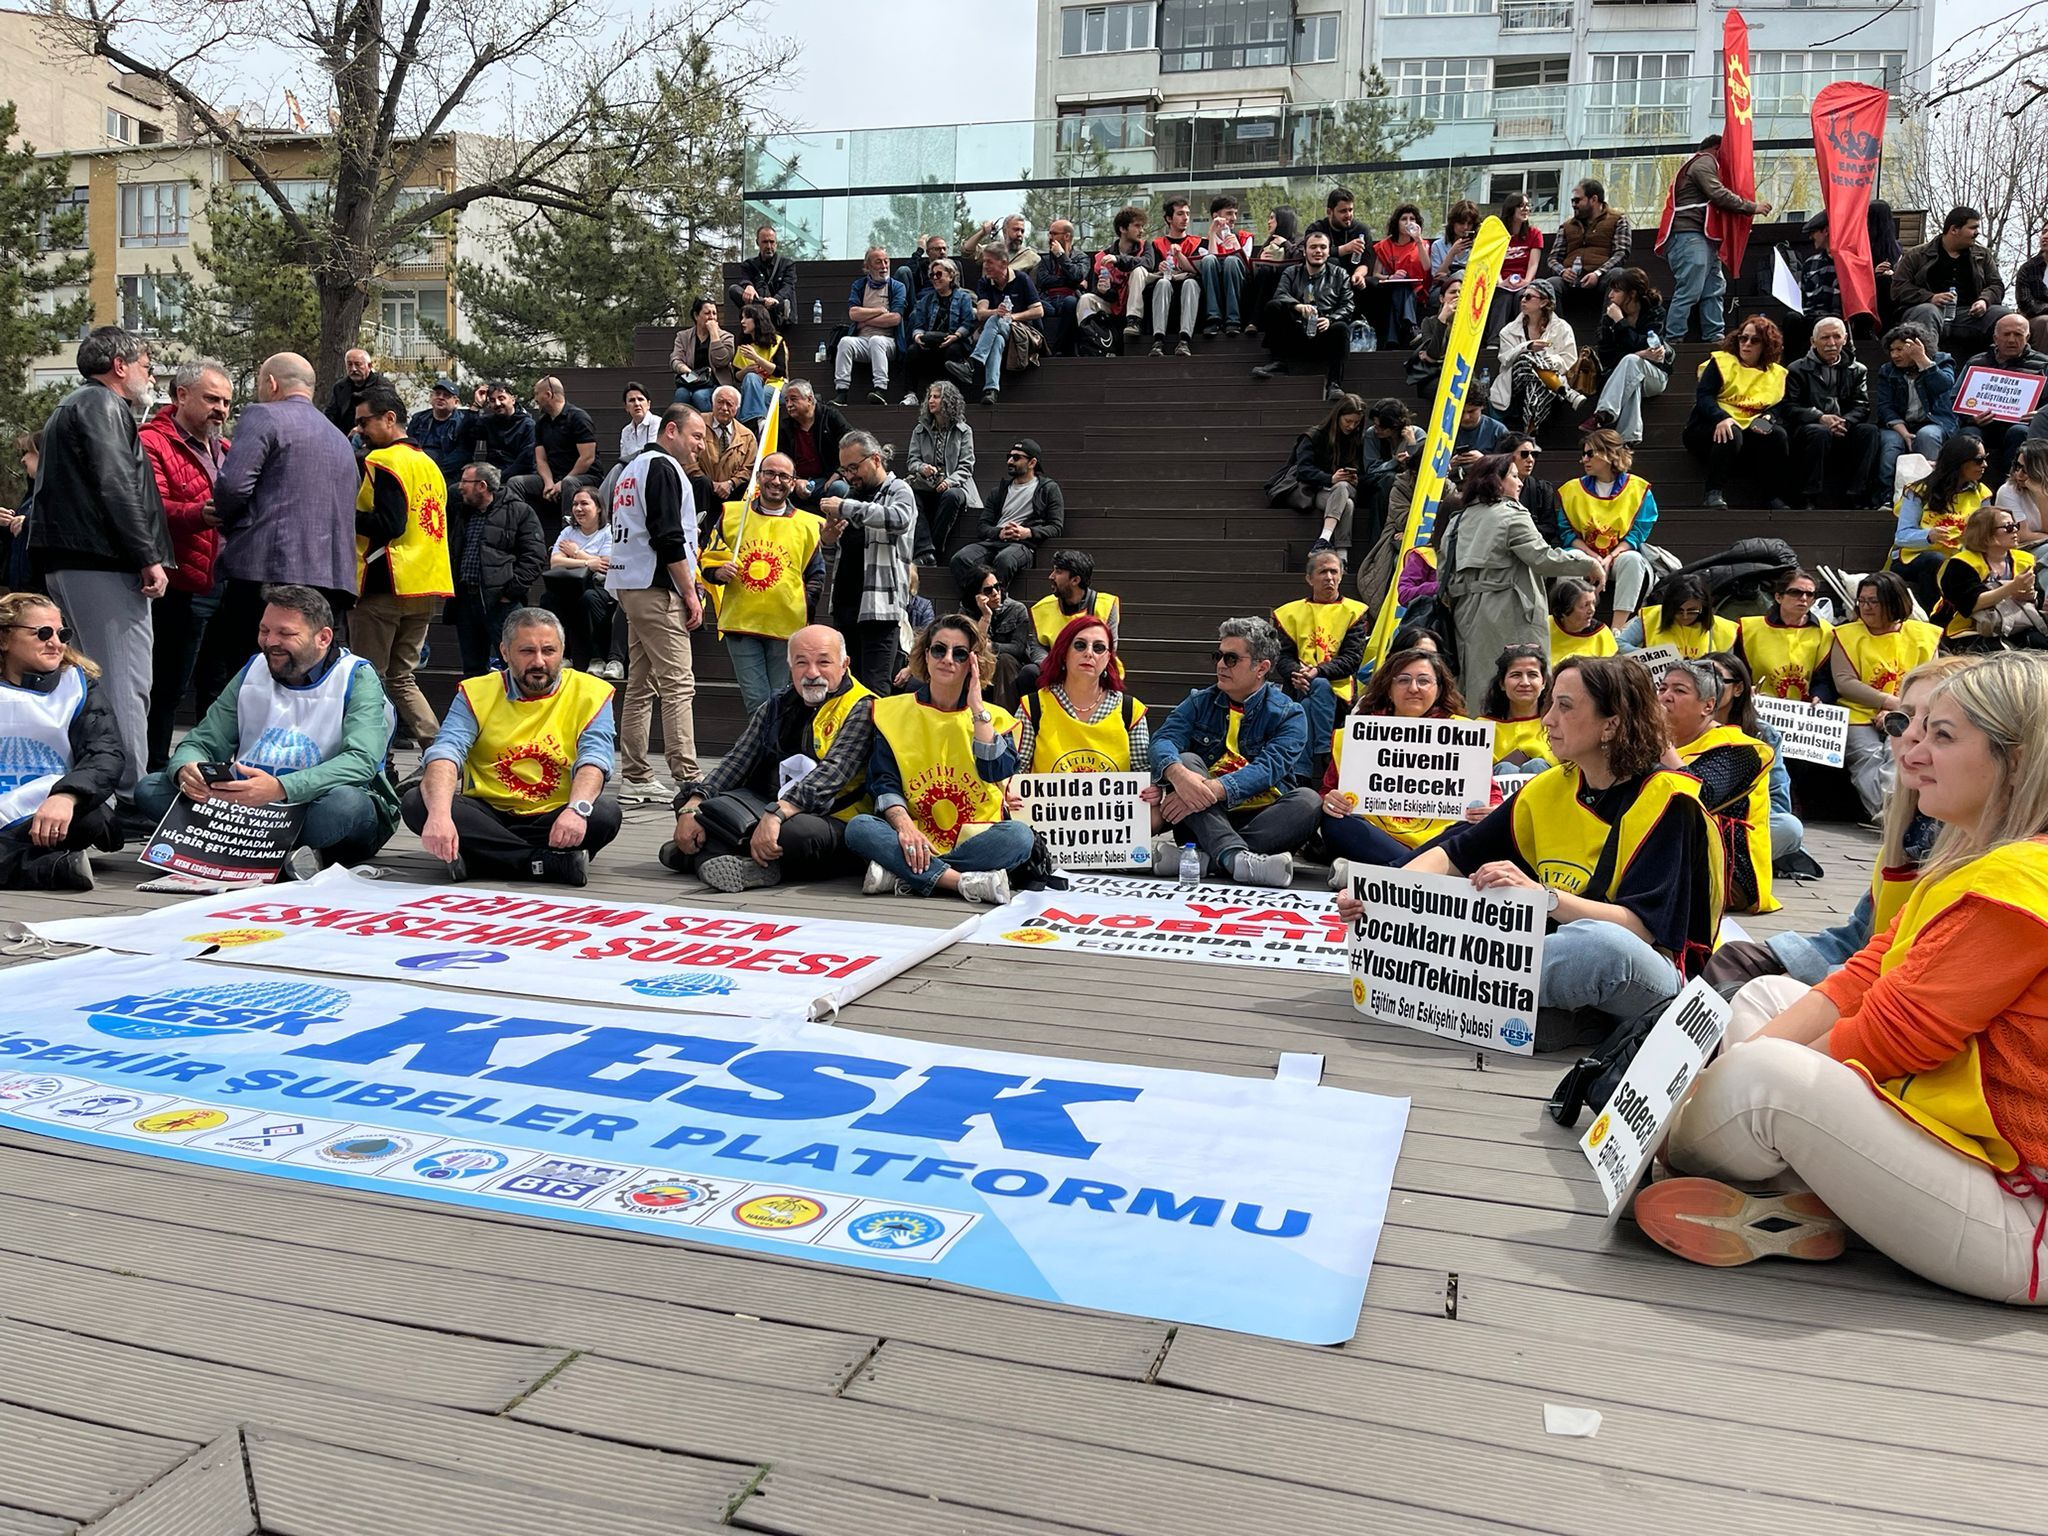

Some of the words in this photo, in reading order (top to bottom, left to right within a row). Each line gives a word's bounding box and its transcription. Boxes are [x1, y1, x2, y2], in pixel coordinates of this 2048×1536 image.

[1353, 721, 1431, 744] Güvenli
[1437, 725, 1490, 749] Okul,
[1780, 730, 1842, 752] Tekinİstifa
[1797, 721, 1842, 738] yönet!
[1378, 748, 1459, 771] Güvenli
[960, 772, 990, 804] SEN
[1020, 779, 1093, 798] Okulda
[1099, 778, 1138, 796] Can
[1369, 773, 1465, 797] Gelecek!
[192, 803, 213, 816] BİR
[214, 810, 246, 825] KATİL
[248, 818, 291, 829] YARATAN
[230, 803, 287, 819] ÇOCUKTAN
[1031, 801, 1134, 822] Güvenliği
[1364, 797, 1387, 812] Eğitim
[1389, 798, 1402, 811] Sen
[1403, 799, 1436, 816] Eskişehir
[1437, 801, 1462, 817] Şubesi
[185, 825, 275, 849] SORGULAMADAN
[208, 820, 269, 838] KARANLIĞI
[1040, 826, 1131, 847] stiyoruz!
[160, 828, 203, 849] HİÇBİR
[204, 843, 227, 855] ŞEY
[228, 847, 286, 859] YAPILAMAZ!
[1059, 852, 1072, 864] Sen
[1073, 851, 1104, 866] Eskişehir
[1105, 850, 1126, 867] Şubesi
[1130, 852, 1150, 860] KESK
[1544, 868, 1581, 890] İTİM
[1353, 876, 1466, 920] Koltuğunu
[1471, 897, 1533, 932] değil
[398, 894, 652, 928] EĞİTİM
[641, 916, 801, 942] SEN
[205, 903, 592, 952] ESKİŞEHİR
[573, 937, 881, 979] ŞUBESİ
[1021, 918, 1252, 948] OKULLARDA
[1264, 941, 1348, 956] ÖLM
[1354, 913, 1455, 958] Çocukları
[1459, 934, 1533, 973] KORU!
[1076, 940, 1194, 955] Eğitim
[1209, 951, 1280, 962] Sen
[619, 977, 740, 996] KESK
[1351, 948, 1534, 1012] #YusufTekinİstifa
[74, 994, 344, 1036] KESK
[1370, 989, 1396, 1016] Eğitim
[1397, 997, 1414, 1019] Sen
[1416, 1001, 1458, 1031] Eskişehir
[1460, 1012, 1493, 1038] Şubesi
[1500, 1027, 1533, 1042] KESK
[280, 1007, 1144, 1160] KESK
[217, 1069, 639, 1142] ŞUBELER
[651, 1124, 1312, 1238] PLATFORMU
[509, 1176, 581, 1198] BTS
[627, 1205, 658, 1215] ESM
